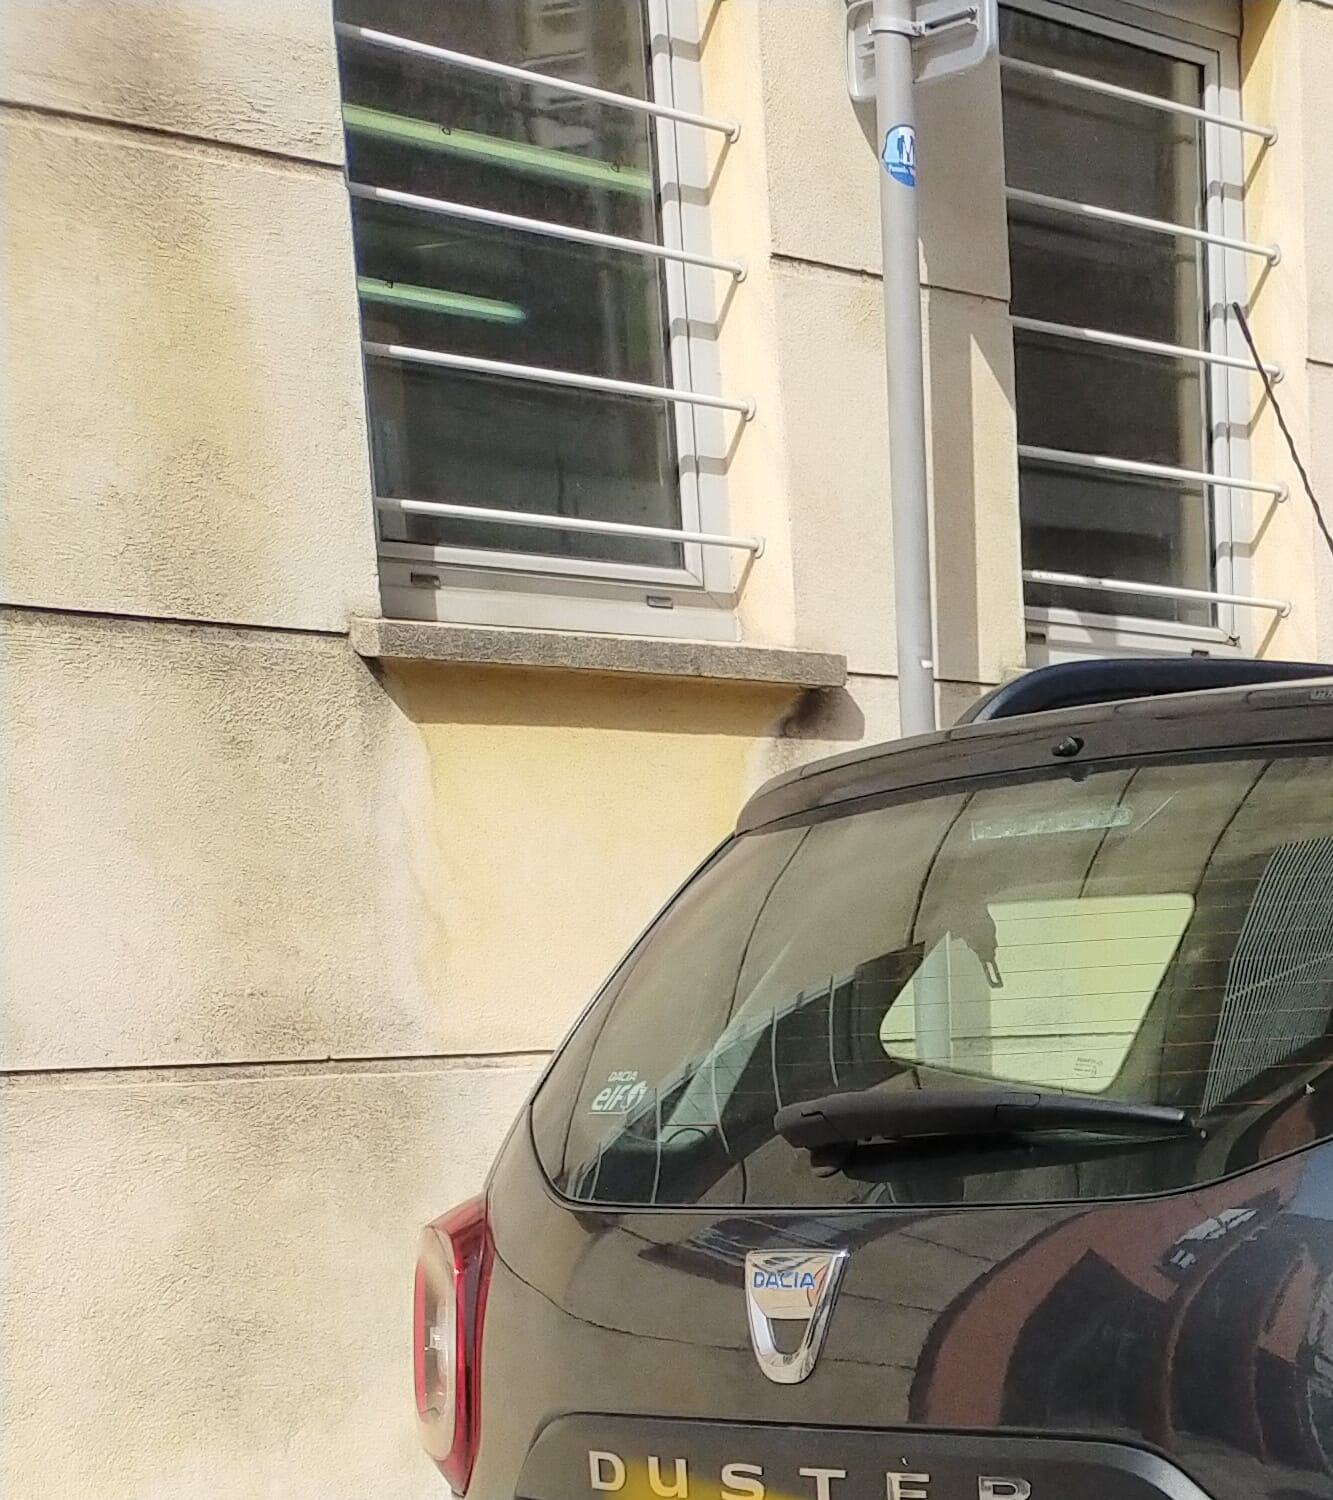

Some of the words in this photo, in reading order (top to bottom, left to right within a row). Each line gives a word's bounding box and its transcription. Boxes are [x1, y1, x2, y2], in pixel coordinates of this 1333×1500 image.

[607, 1071, 638, 1082] DACIA
[591, 1084, 633, 1111] elf
[753, 1271, 816, 1289] DACIA
